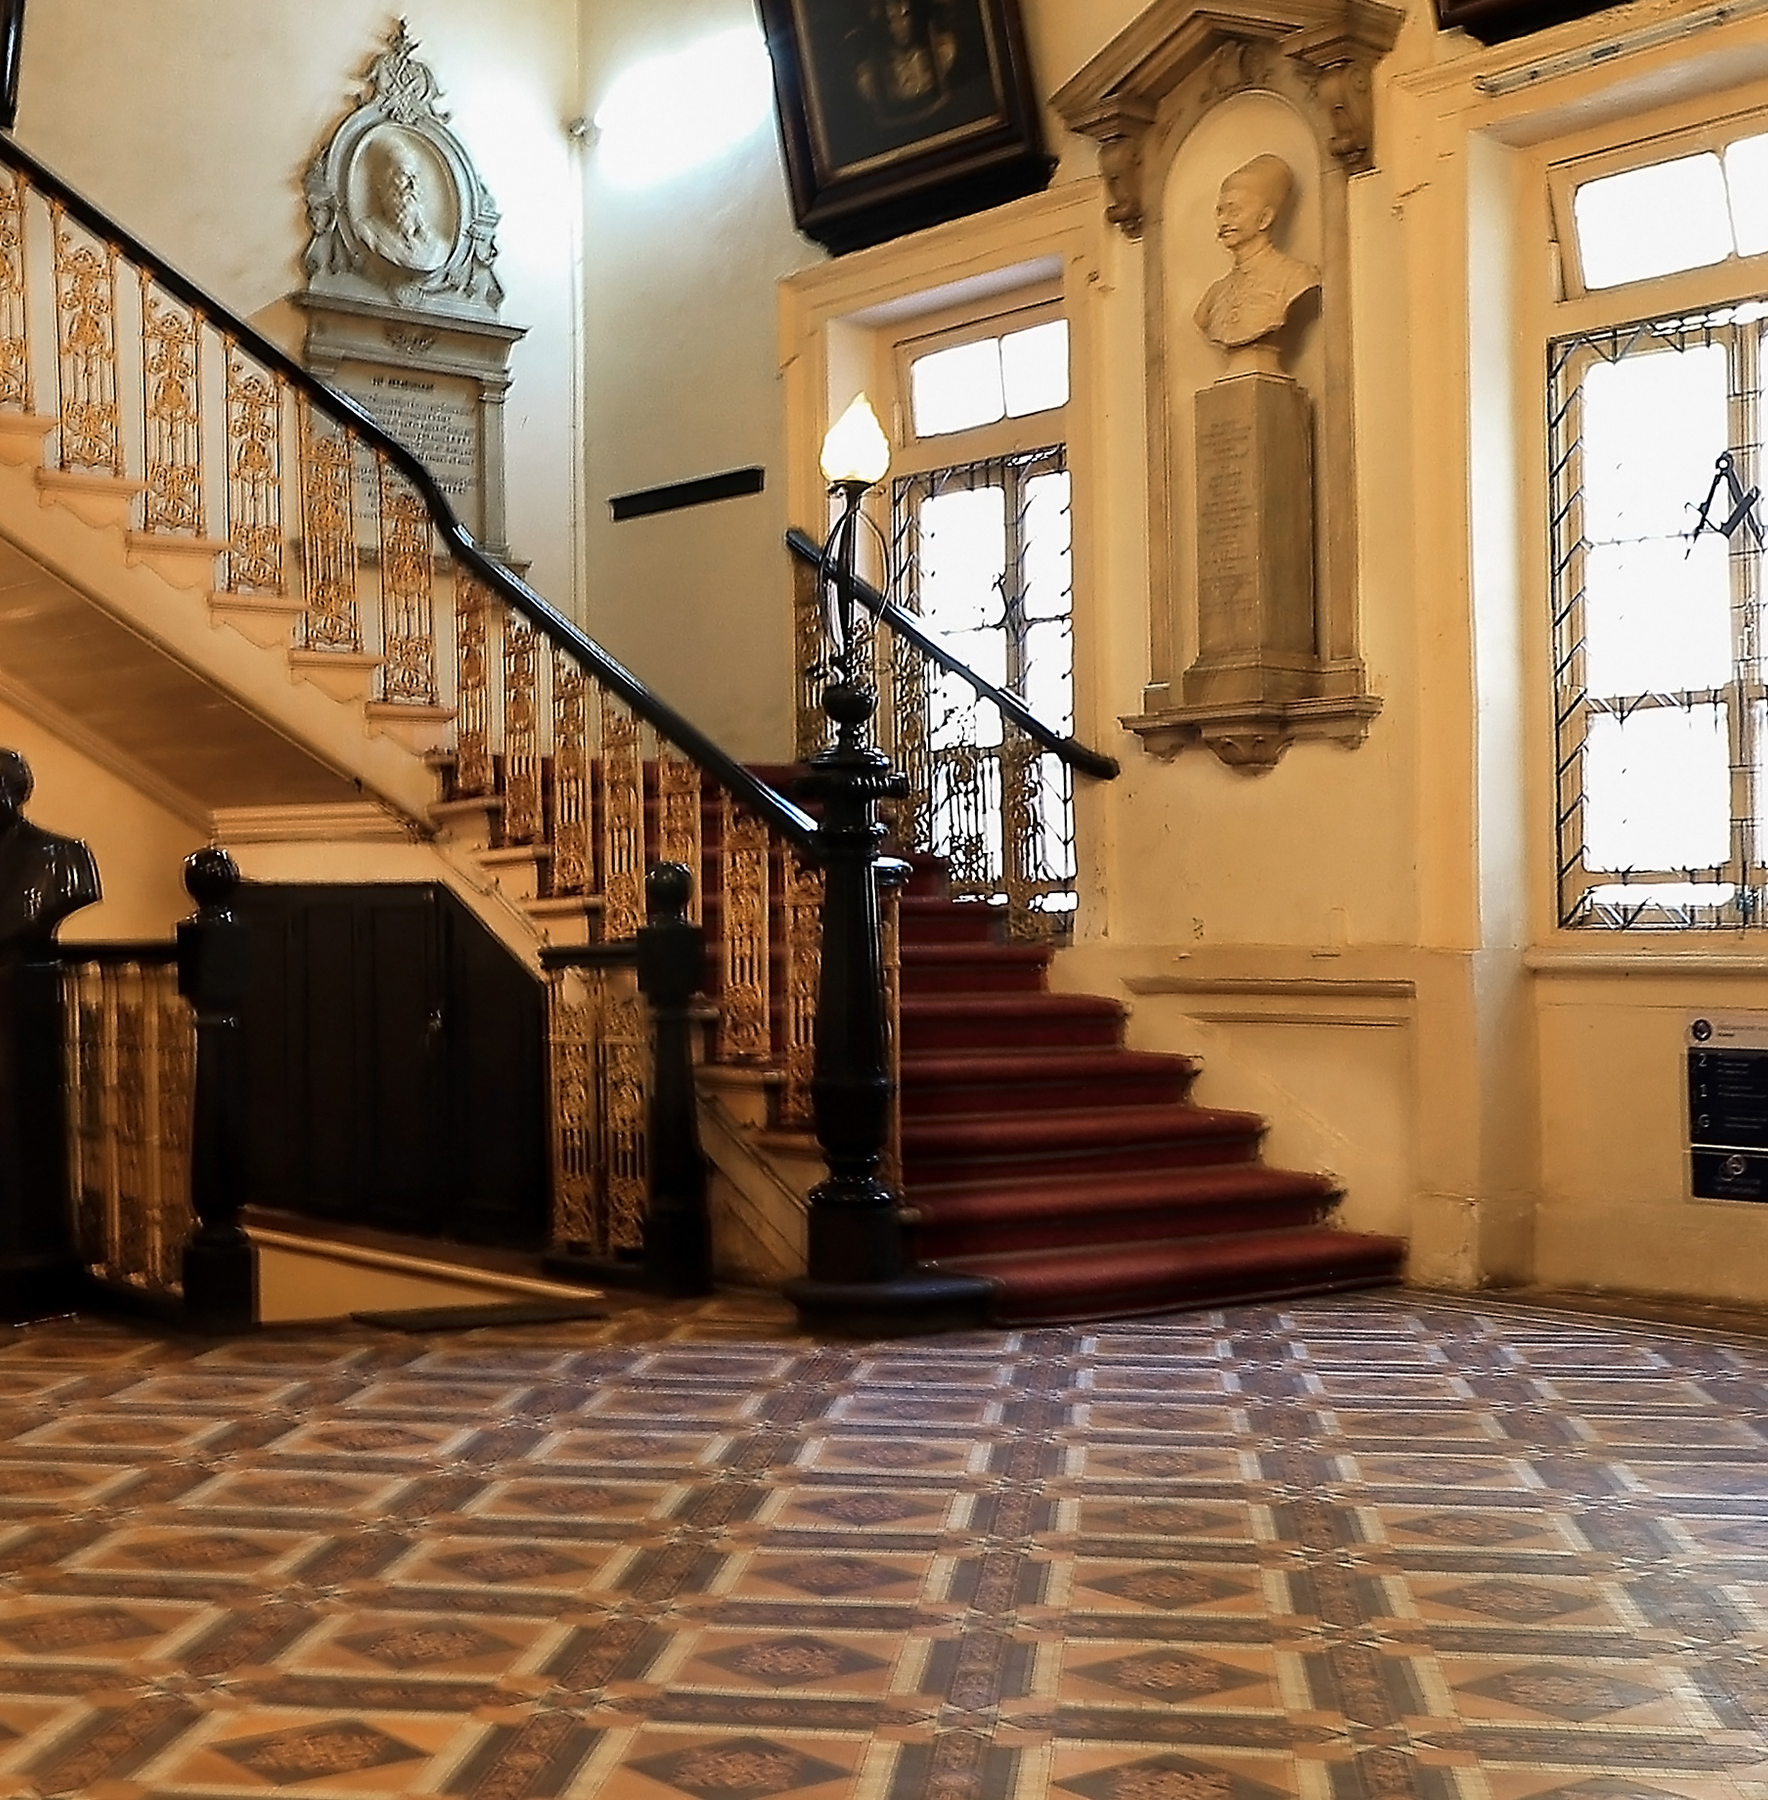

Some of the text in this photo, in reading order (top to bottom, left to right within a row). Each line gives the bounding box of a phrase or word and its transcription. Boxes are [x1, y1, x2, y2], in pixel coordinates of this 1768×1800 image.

[1699, 1052, 1707, 1067] 2
[1700, 1084, 1708, 1097] 1
[1698, 1114, 1709, 1128] G
